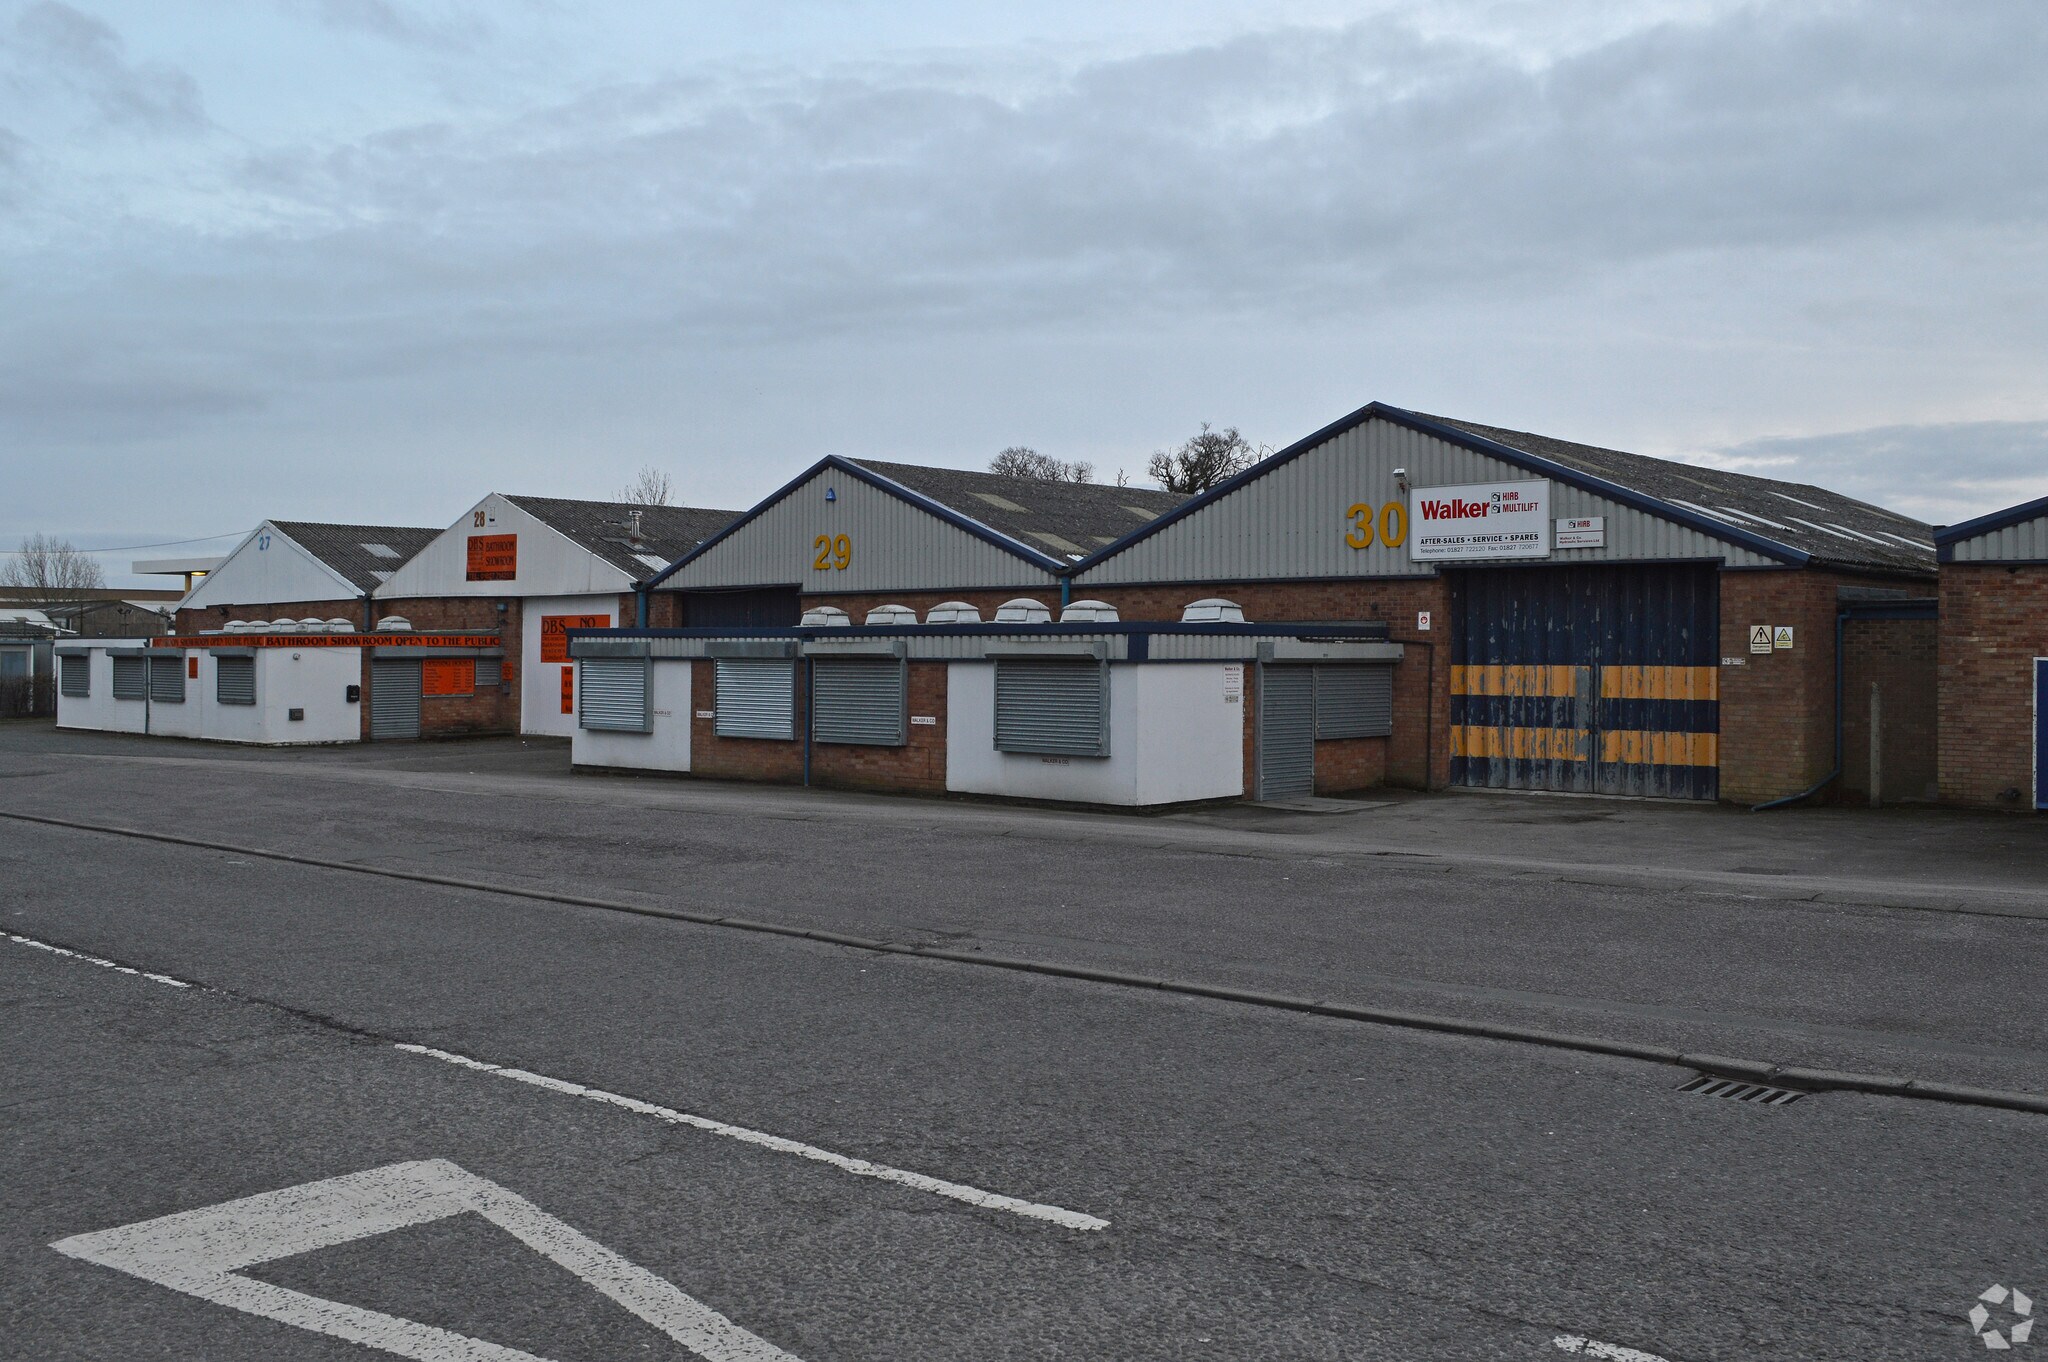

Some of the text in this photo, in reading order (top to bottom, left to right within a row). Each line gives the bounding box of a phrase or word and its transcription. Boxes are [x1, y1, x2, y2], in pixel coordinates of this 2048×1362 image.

[1502, 492, 1519, 501] HIAB
[1420, 499, 1539, 520] Walker MULTILIFT
[474, 511, 486, 528] 28
[1346, 502, 1408, 549] 30
[259, 536, 270, 550] 27
[1420, 537, 1465, 545] AFTER-SALES
[814, 534, 851, 570] 29
[542, 619, 566, 634] DBS
[580, 617, 596, 628] NO
[267, 636, 327, 646] BATHROOM
[396, 636, 422, 646] OPEN
[426, 636, 440, 646] TO
[442, 636, 460, 646] THE
[464, 636, 500, 646] PUBLIC
